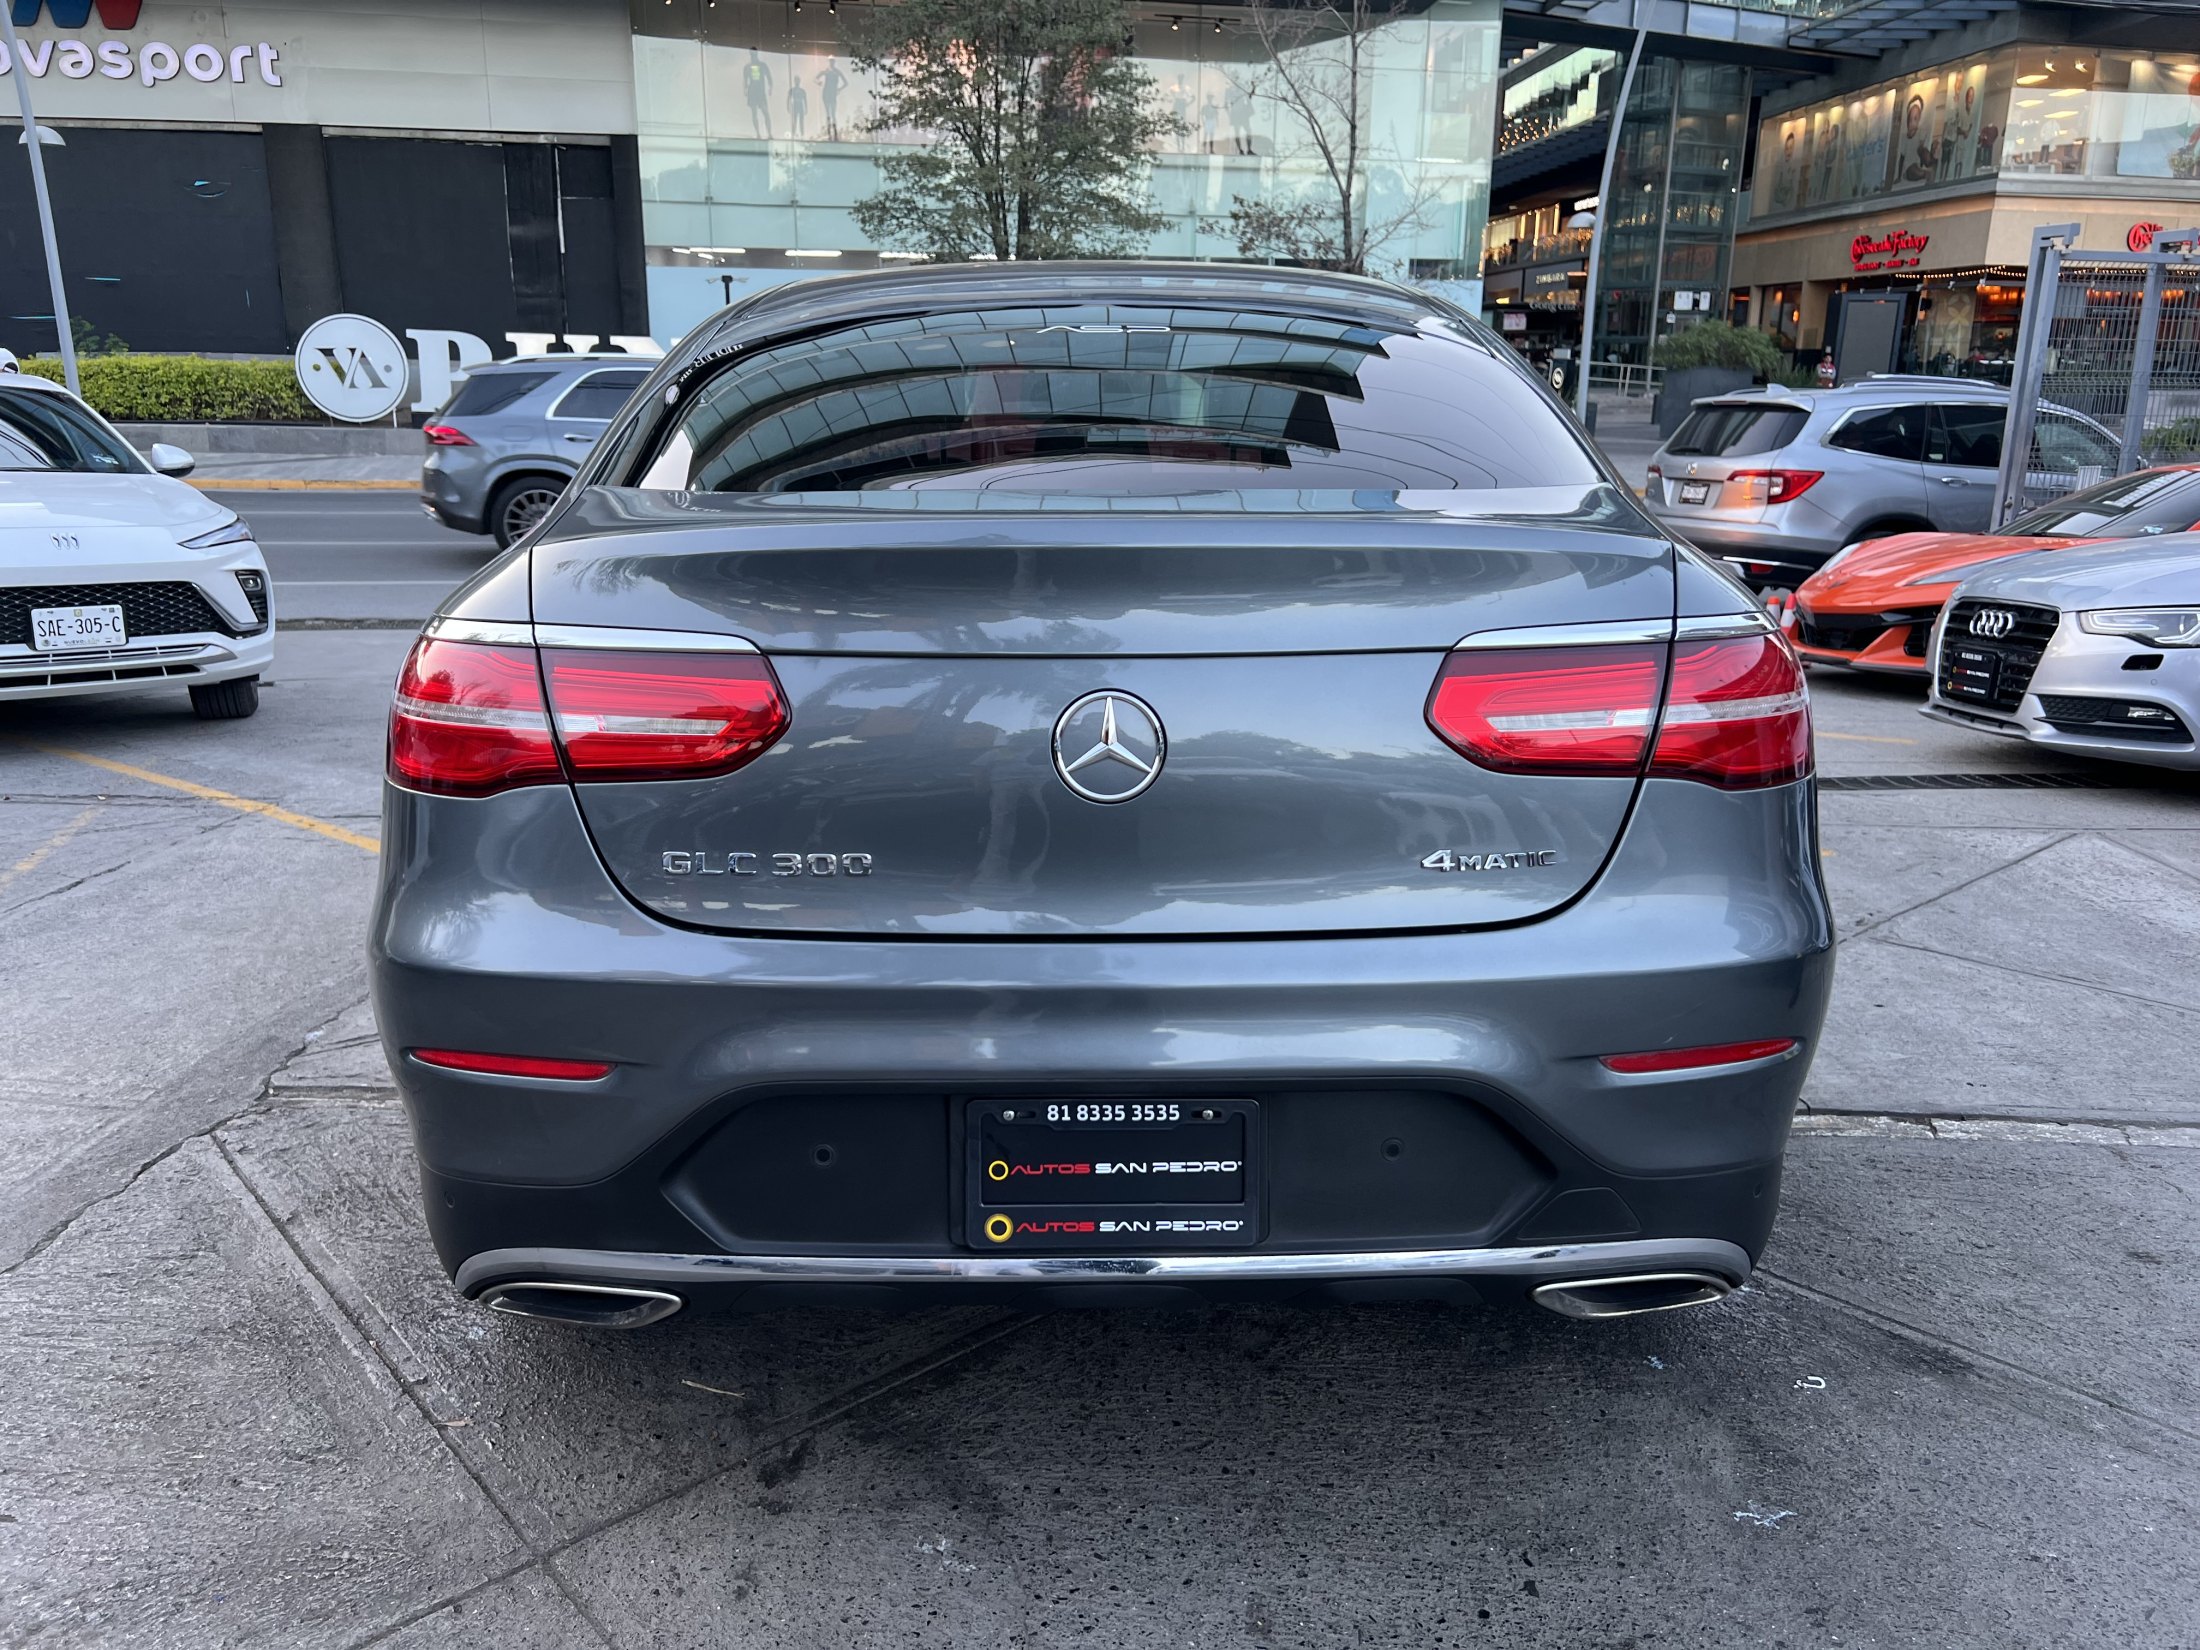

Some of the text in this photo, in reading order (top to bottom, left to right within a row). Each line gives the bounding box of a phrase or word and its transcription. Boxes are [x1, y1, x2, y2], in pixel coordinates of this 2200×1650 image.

[37, 616, 121, 637] SAE-305-C
[661, 850, 873, 877] GLC 300
[1420, 849, 1558, 872] 4MATIC
[1047, 1104, 1180, 1122] 81 8335 3535
[1010, 1163, 1091, 1176] AUTOS
[1095, 1162, 1147, 1174] SAN
[1016, 1221, 1095, 1233] AUTOS
[1099, 1220, 1150, 1232] SAN
